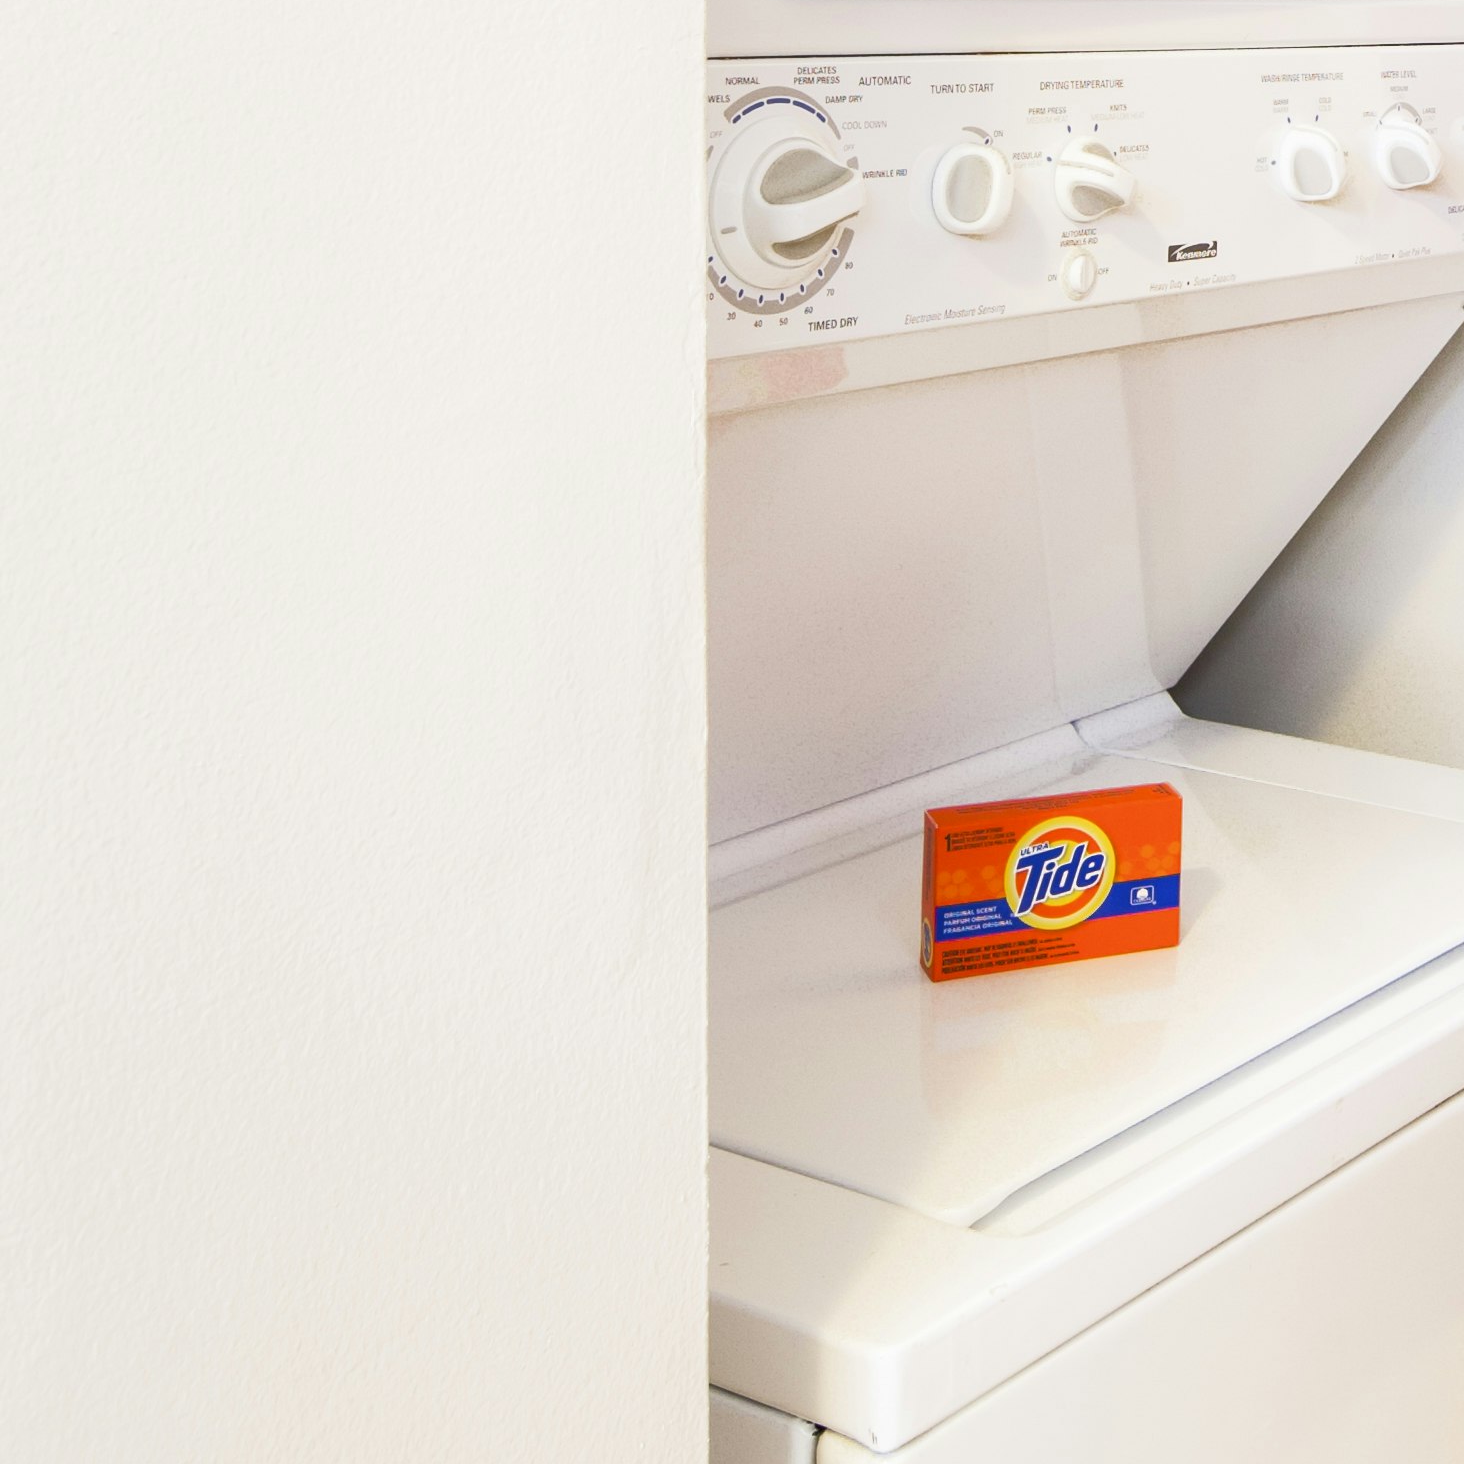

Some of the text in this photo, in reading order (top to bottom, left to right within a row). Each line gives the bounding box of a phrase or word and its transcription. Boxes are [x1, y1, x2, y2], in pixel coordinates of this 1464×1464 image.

[797, 66, 836, 75] DELICATES
[1401, 70, 1416, 78] LEVEL
[726, 77, 760, 85] NORMAL
[793, 76, 840, 85] PERM PRESS
[859, 76, 911, 87] AUTOMATIC
[1301, 73, 1344, 81] TEMPERATURE
[930, 83, 994, 94] TURN TO START
[1040, 79, 1124, 91] DRYING TEMPERATURE
[825, 95, 847, 103] DAMP
[842, 121, 887, 129] COOL DOWN
[1120, 145, 1150, 153] DELICATES
[1012, 152, 1042, 160] REGULAR
[862, 169, 908, 179] WRINKLE RID
[1060, 228, 1097, 238] AUTOMATIC
[1088, 237, 1098, 245] RID
[1175, 249, 1216, 260] Kenmore
[1150, 274, 1236, 292] Heavy Duty Super Capacity
[727, 312, 736, 321] 30
[904, 304, 1006, 326] Electronic Moisture Sensing
[780, 317, 788, 326] 50
[808, 317, 859, 332] TIMED DRY
[945, 833, 952, 851] 1
[1020, 842, 1049, 856] ULTRA
[1015, 842, 1106, 916] Tide
[944, 906, 996, 918] ORIGINAL SCENT
[944, 914, 1002, 926] PARFUM ORIGINAL
[944, 920, 1012, 933] FRAGANCIA ORIGINAL
